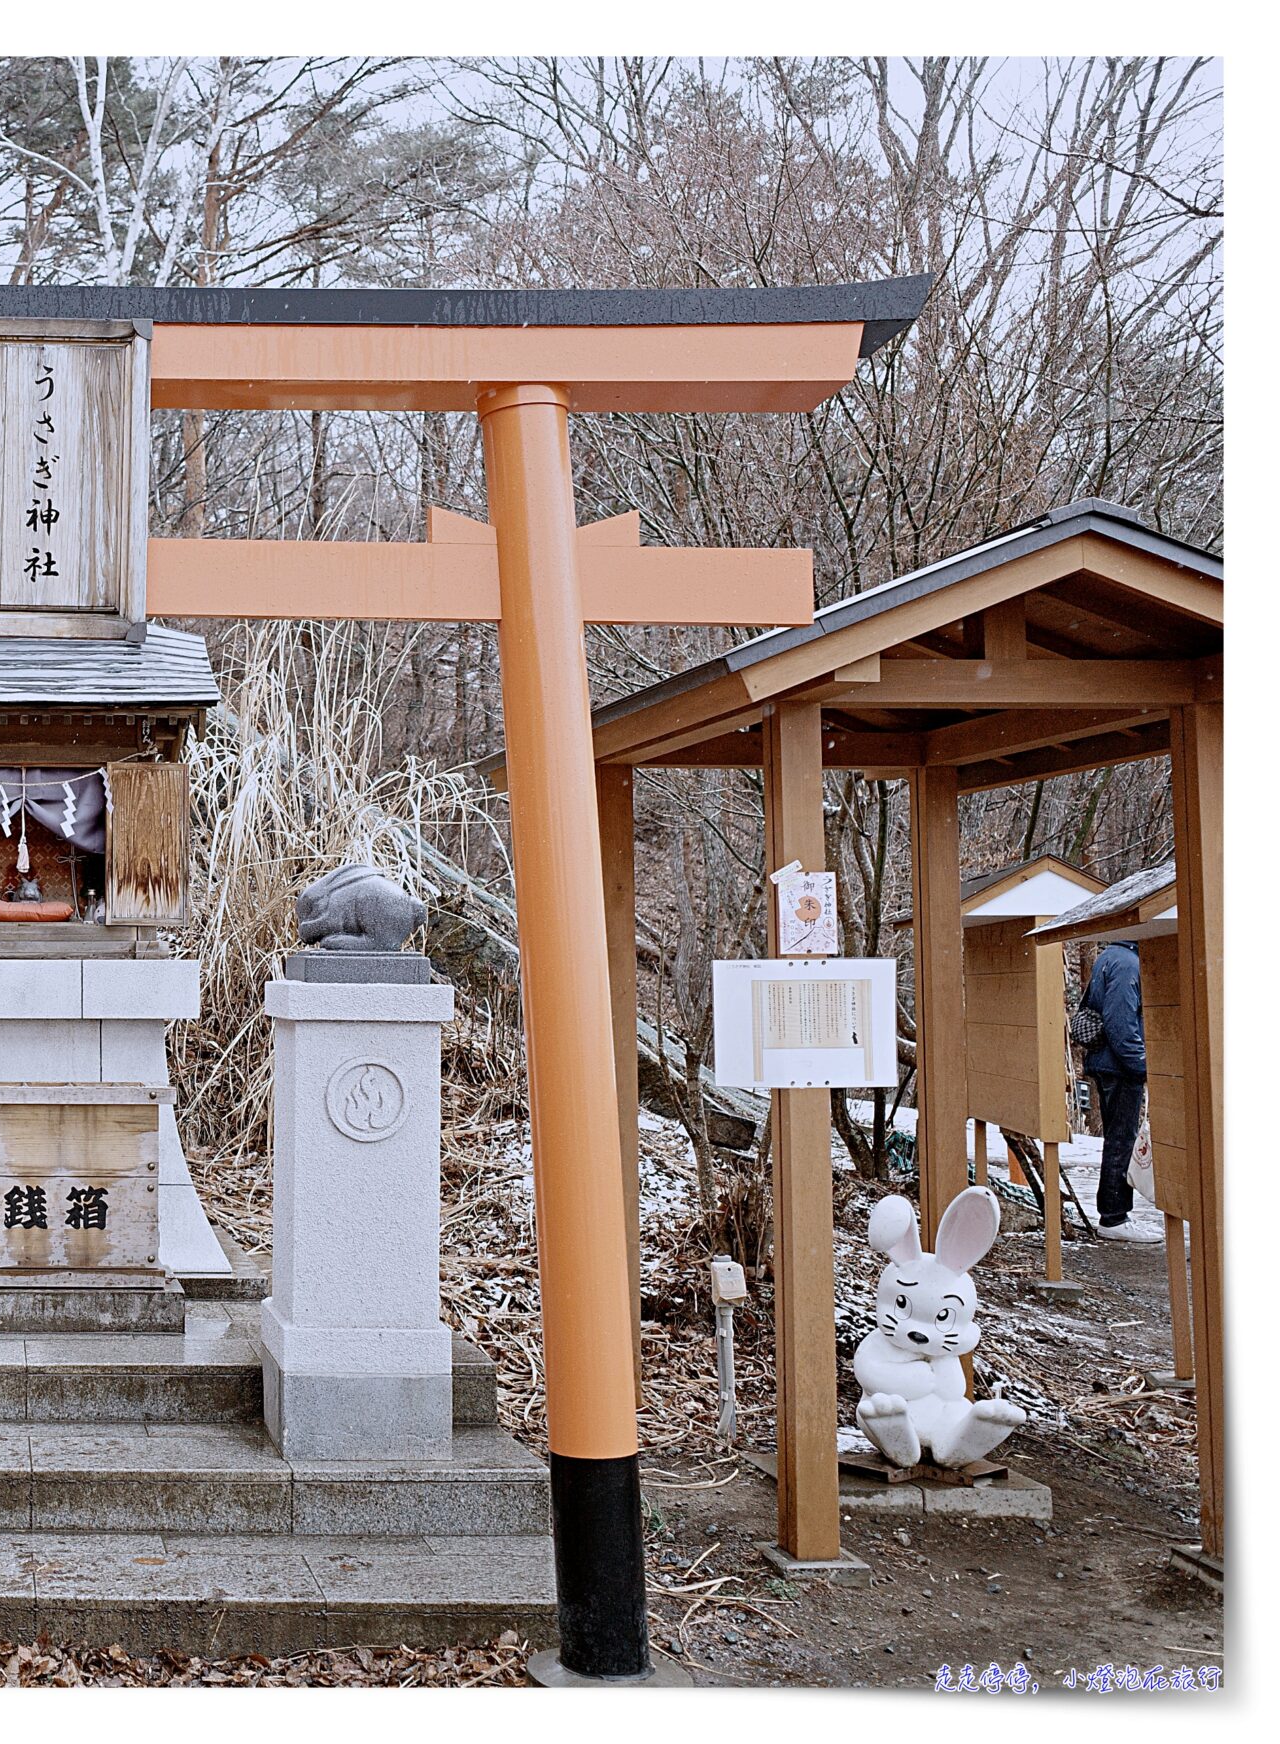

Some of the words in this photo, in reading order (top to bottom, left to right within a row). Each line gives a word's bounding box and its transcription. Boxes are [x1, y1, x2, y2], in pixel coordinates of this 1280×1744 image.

[23, 364, 61, 583] うさぎ神社
[800, 880, 816, 929] 御朱印
